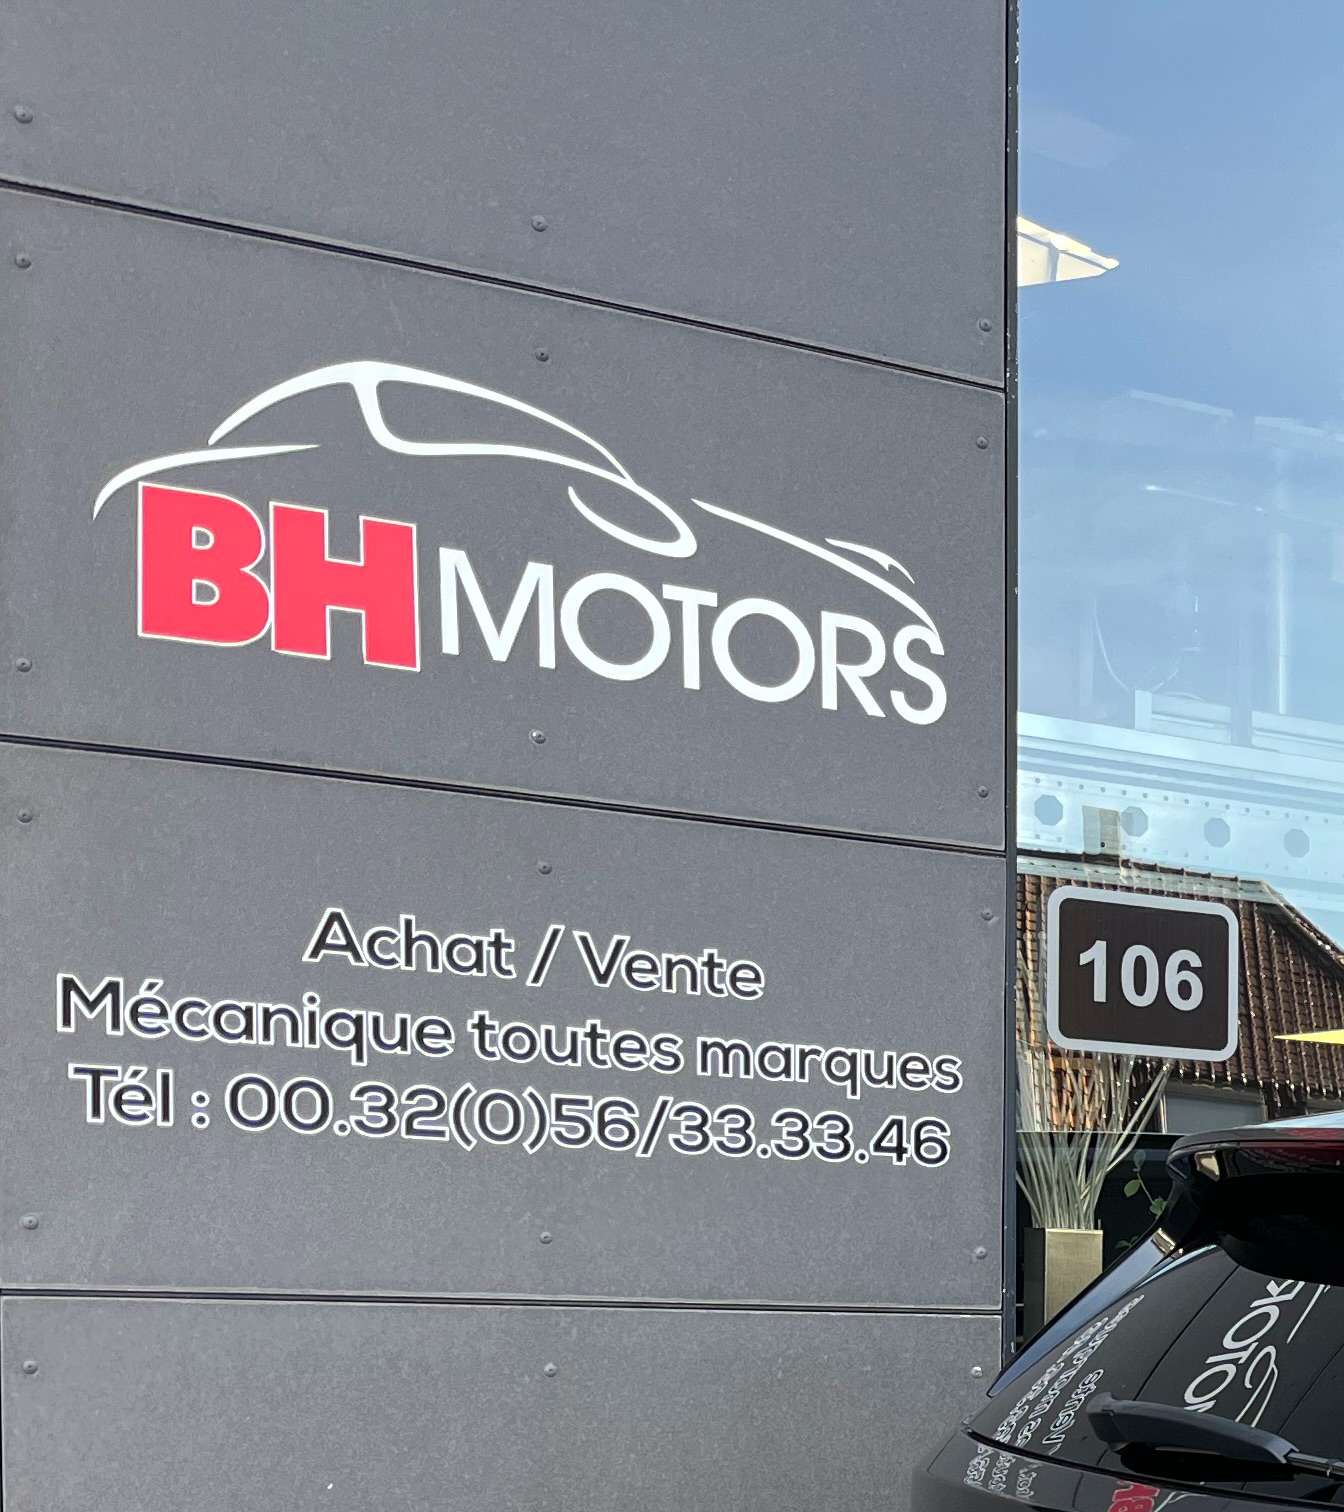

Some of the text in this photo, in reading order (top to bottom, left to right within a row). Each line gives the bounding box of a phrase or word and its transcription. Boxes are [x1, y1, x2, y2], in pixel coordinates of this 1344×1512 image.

[136, 480, 948, 726] BH MOTORS
[302, 906, 518, 980] Achat
[571, 929, 766, 1001] Vente
[1079, 939, 1204, 1011] 106
[55, 972, 964, 1101] Mécanique toutes marques
[67, 1061, 175, 1128] Tél
[225, 1072, 952, 1168] 00.32(0)56/33.33.46
